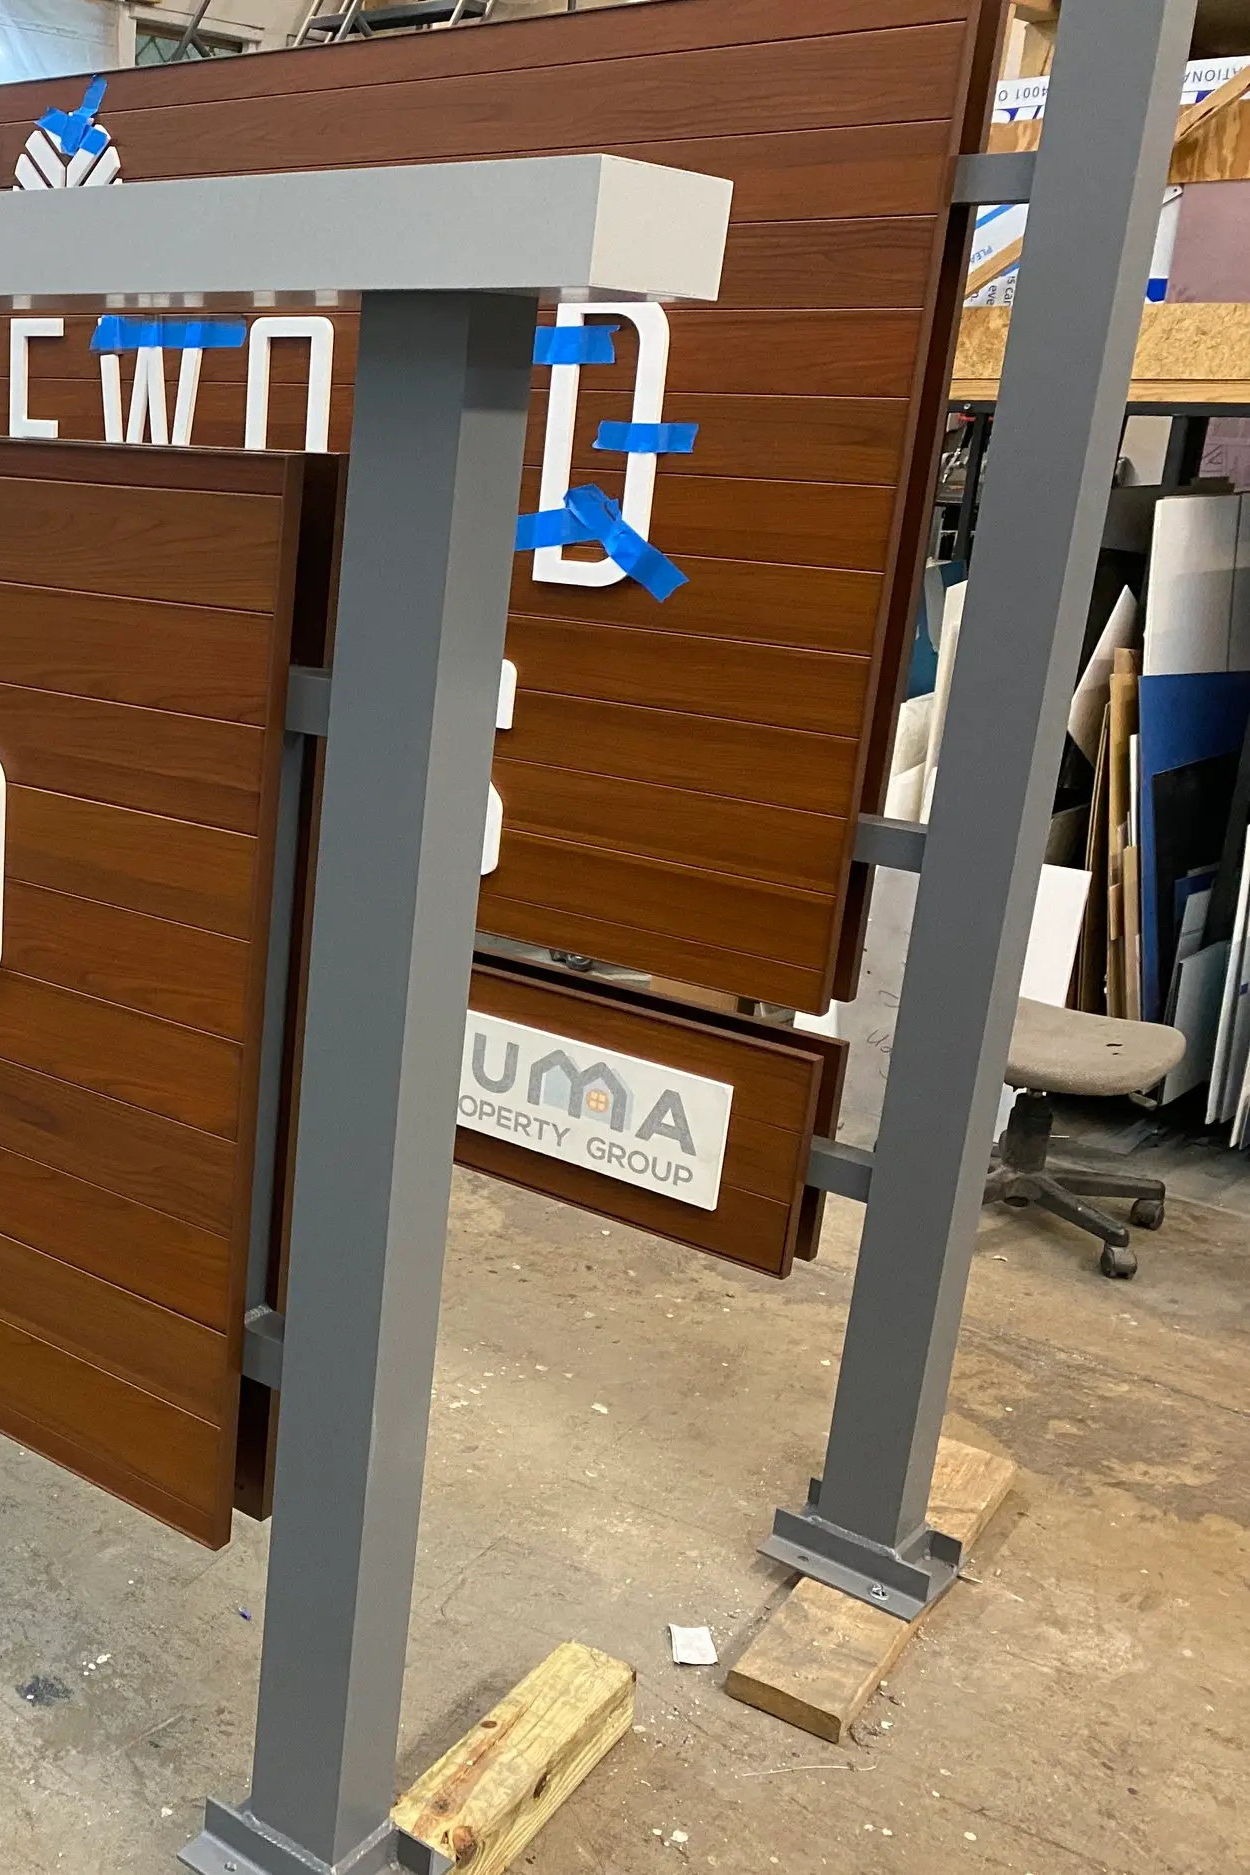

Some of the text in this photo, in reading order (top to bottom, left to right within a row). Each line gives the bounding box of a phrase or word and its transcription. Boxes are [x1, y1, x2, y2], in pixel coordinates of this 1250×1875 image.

[457, 1094, 693, 1187] OPERTY GROUP
[471, 1032, 697, 1157] UMA
